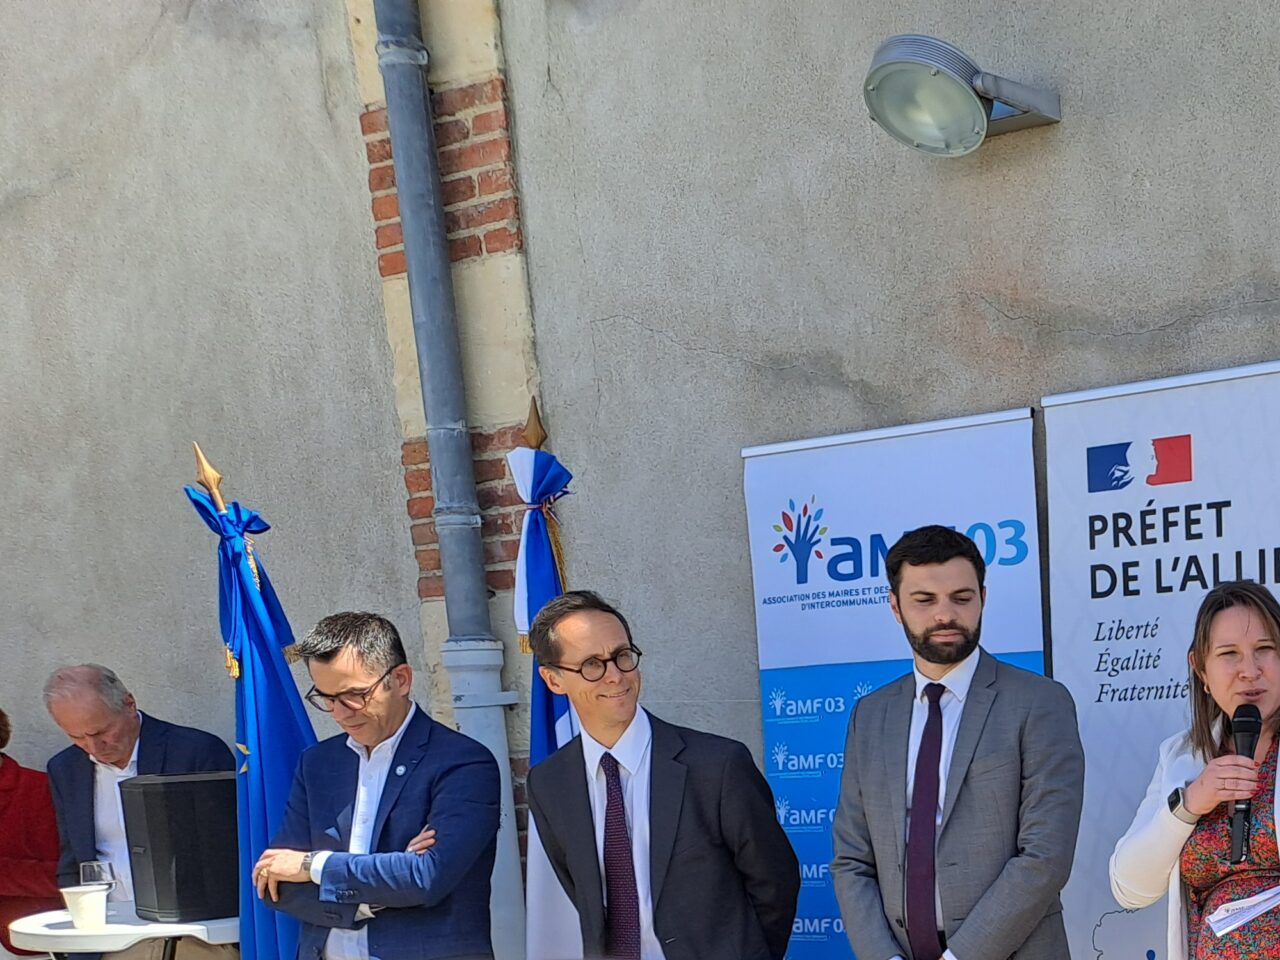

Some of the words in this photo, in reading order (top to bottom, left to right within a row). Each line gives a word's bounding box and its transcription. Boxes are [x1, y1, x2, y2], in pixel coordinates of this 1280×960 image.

[1088, 499, 1232, 550] PRÉFET
[1089, 560, 1141, 599] DE
[762, 593, 810, 605] ASSOCIATION
[812, 591, 826, 600] DES
[828, 588, 860, 598] MAIRES
[861, 587, 872, 596] ET
[1093, 617, 1160, 642] Liberté
[1094, 648, 1162, 676] Égalité
[1094, 679, 1190, 704] Fraternité
